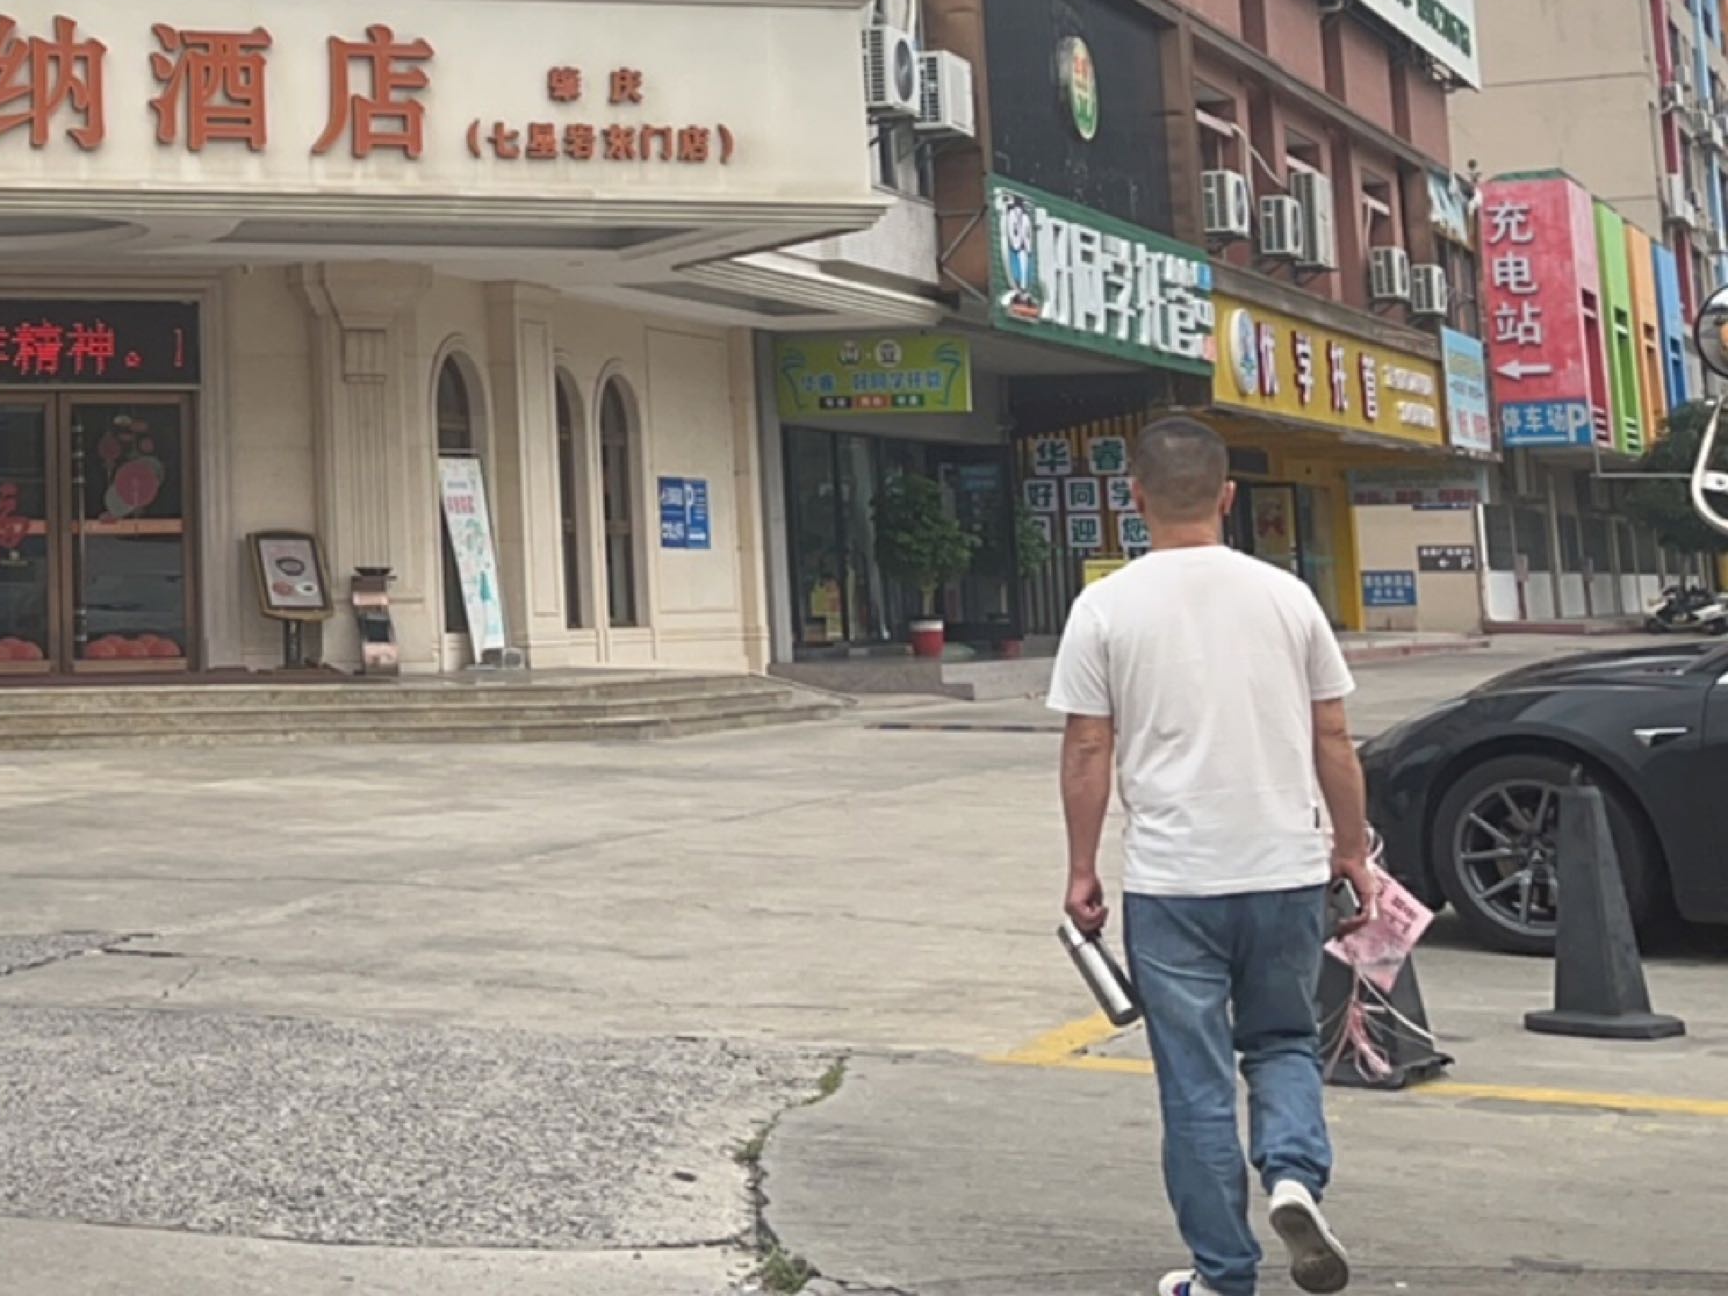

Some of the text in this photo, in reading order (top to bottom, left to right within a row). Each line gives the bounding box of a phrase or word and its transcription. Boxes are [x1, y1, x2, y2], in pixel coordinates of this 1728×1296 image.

[547, 66, 645, 105] 肇庆
[465, 118, 735, 164] (七星岩东门店)
[1486, 200, 1544, 345] 充电站
[1032, 517, 1149, 543] 迎您
